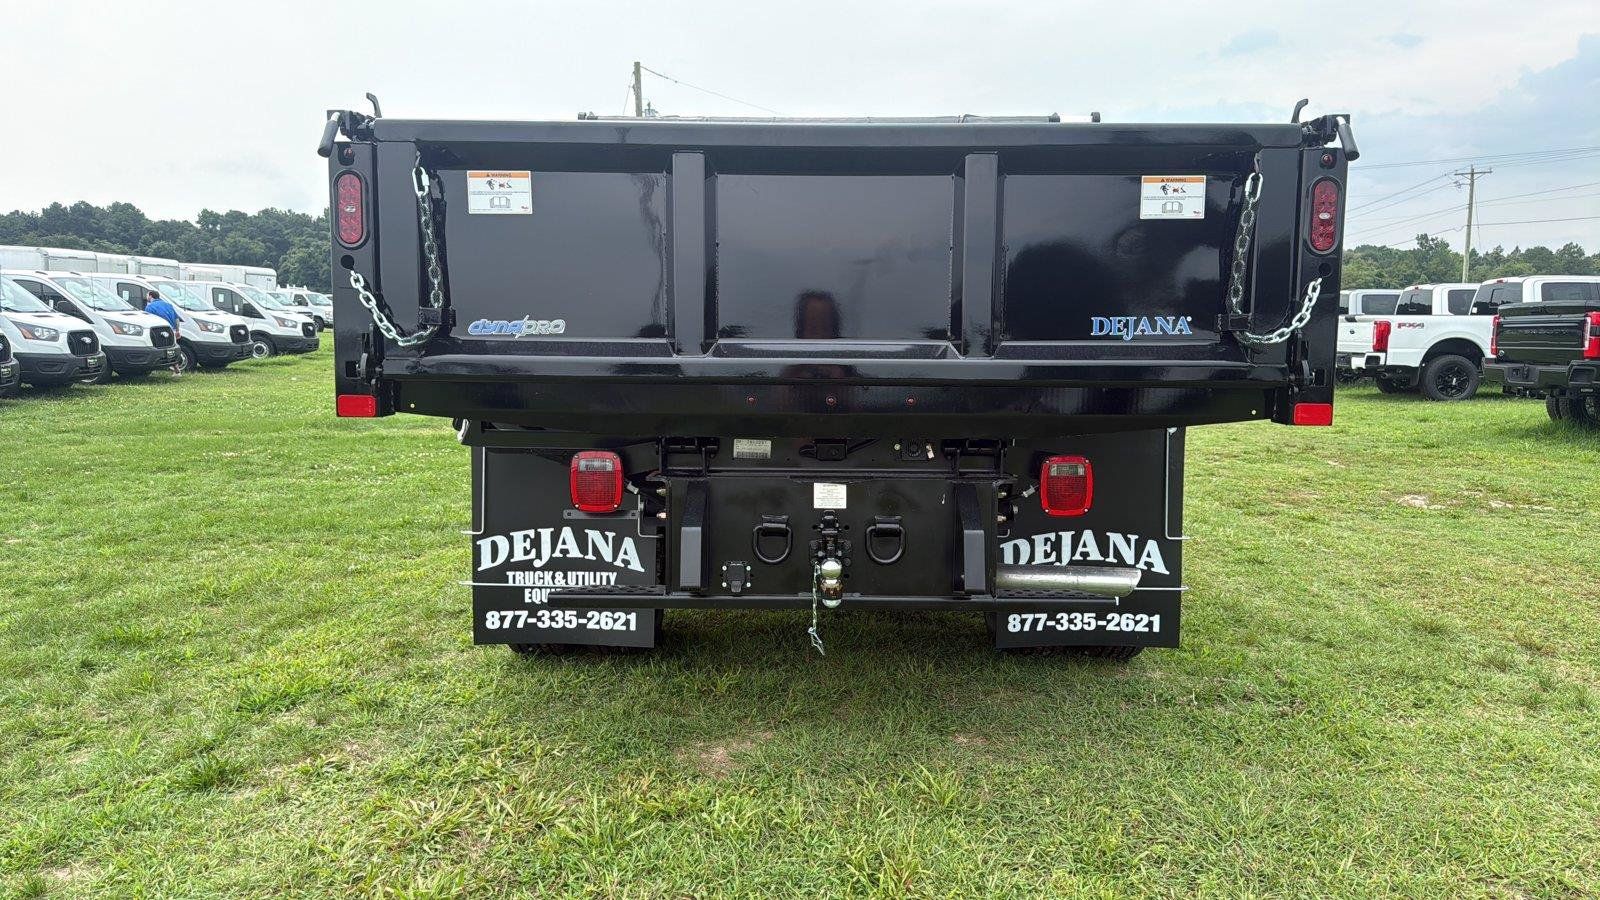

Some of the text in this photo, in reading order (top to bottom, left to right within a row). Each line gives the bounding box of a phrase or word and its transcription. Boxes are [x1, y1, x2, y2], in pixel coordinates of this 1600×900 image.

[476, 526, 645, 573] DEJANA
[1000, 529, 1170, 575] DEJANA
[485, 610, 637, 631] 877-335-2621
[1007, 612, 1160, 633] 877-335-2621
